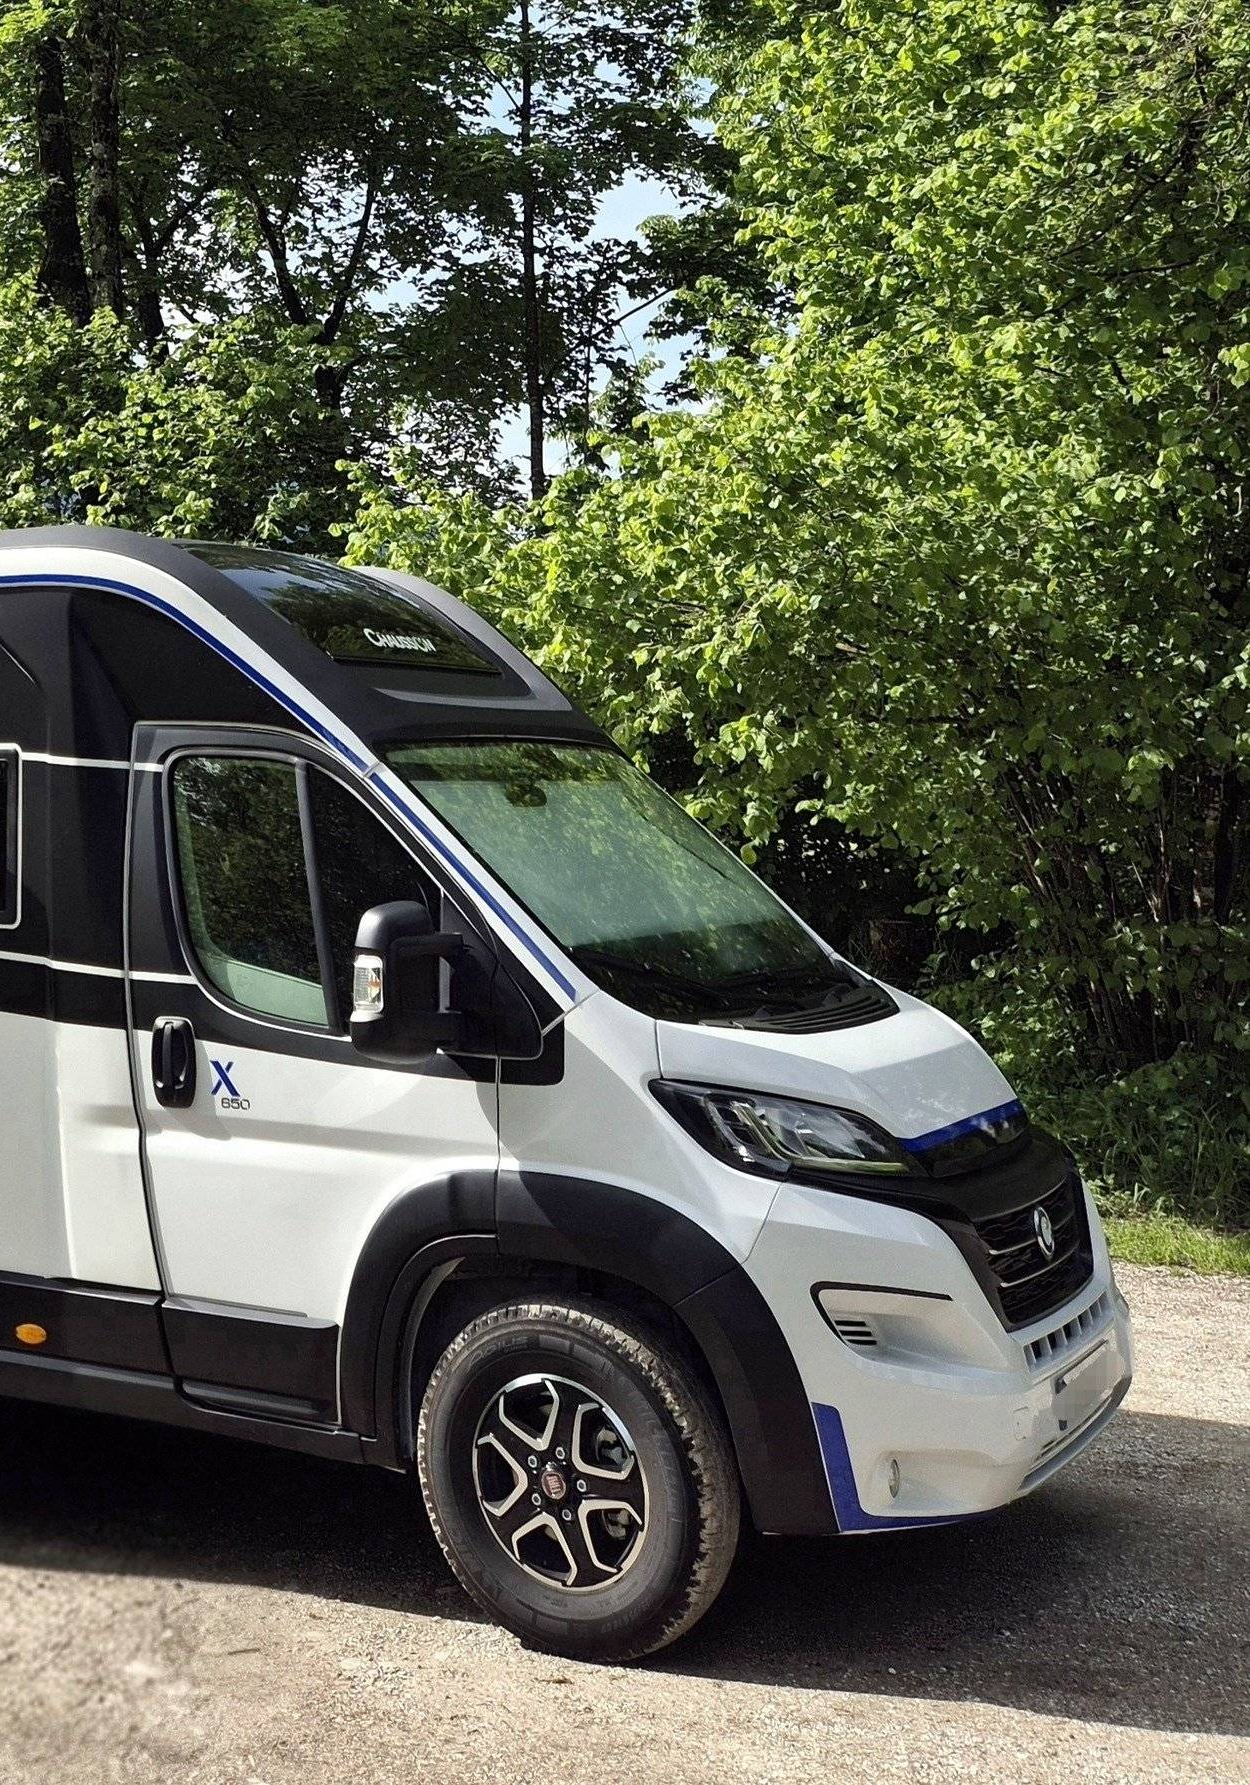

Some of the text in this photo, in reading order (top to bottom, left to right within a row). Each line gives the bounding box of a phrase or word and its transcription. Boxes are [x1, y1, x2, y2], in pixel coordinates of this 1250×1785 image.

[362, 628, 437, 653] CHAUSSON
[209, 1060, 241, 1098] X
[221, 1097, 251, 1111] 650
